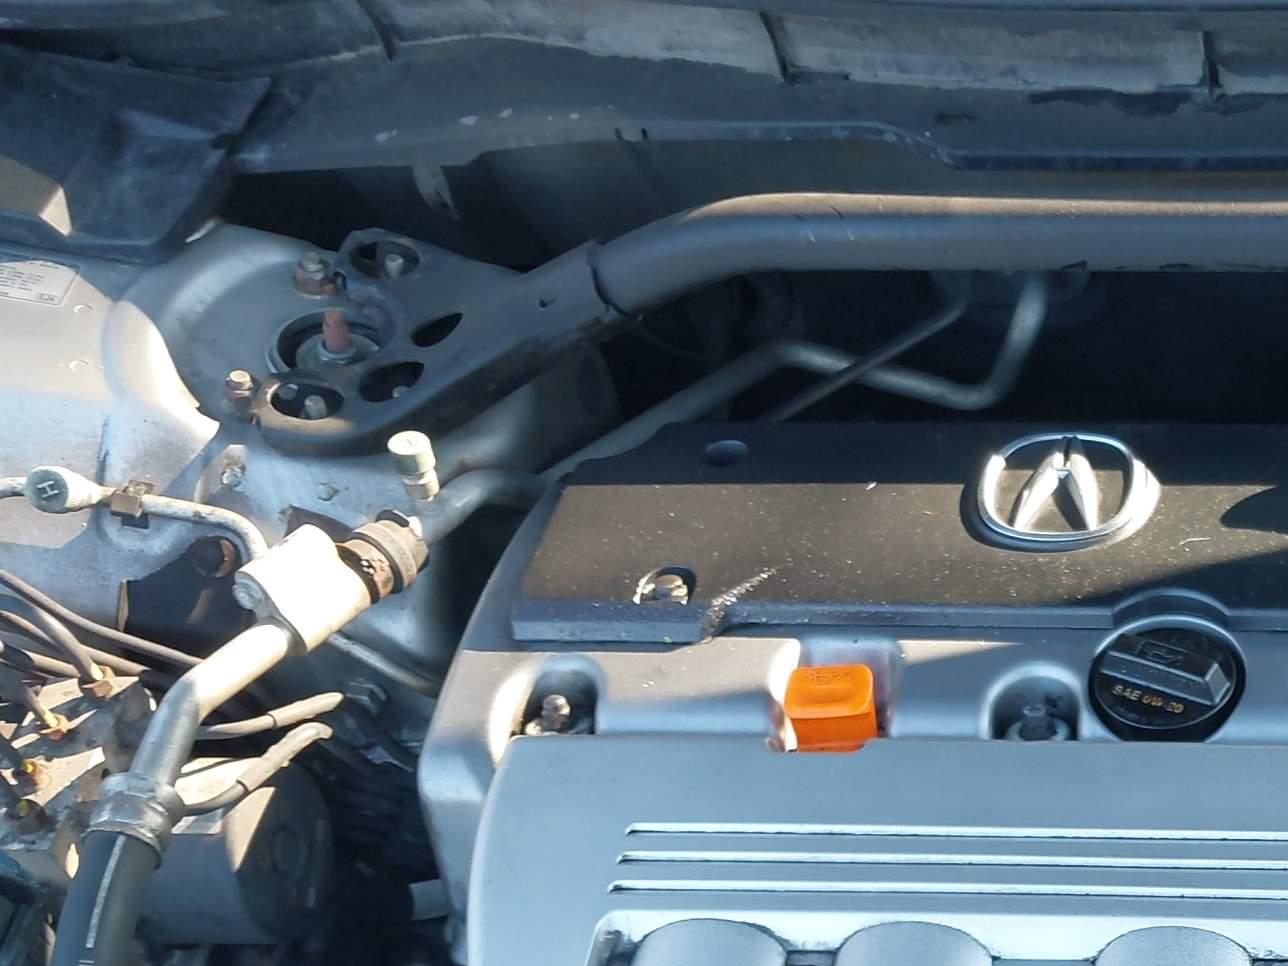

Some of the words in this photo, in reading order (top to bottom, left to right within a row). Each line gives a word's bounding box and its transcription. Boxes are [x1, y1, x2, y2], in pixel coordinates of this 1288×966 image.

[37, 480, 59, 498] H
[1112, 685, 1141, 700] SAE
[1142, 695, 1184, 714] 0W-20
